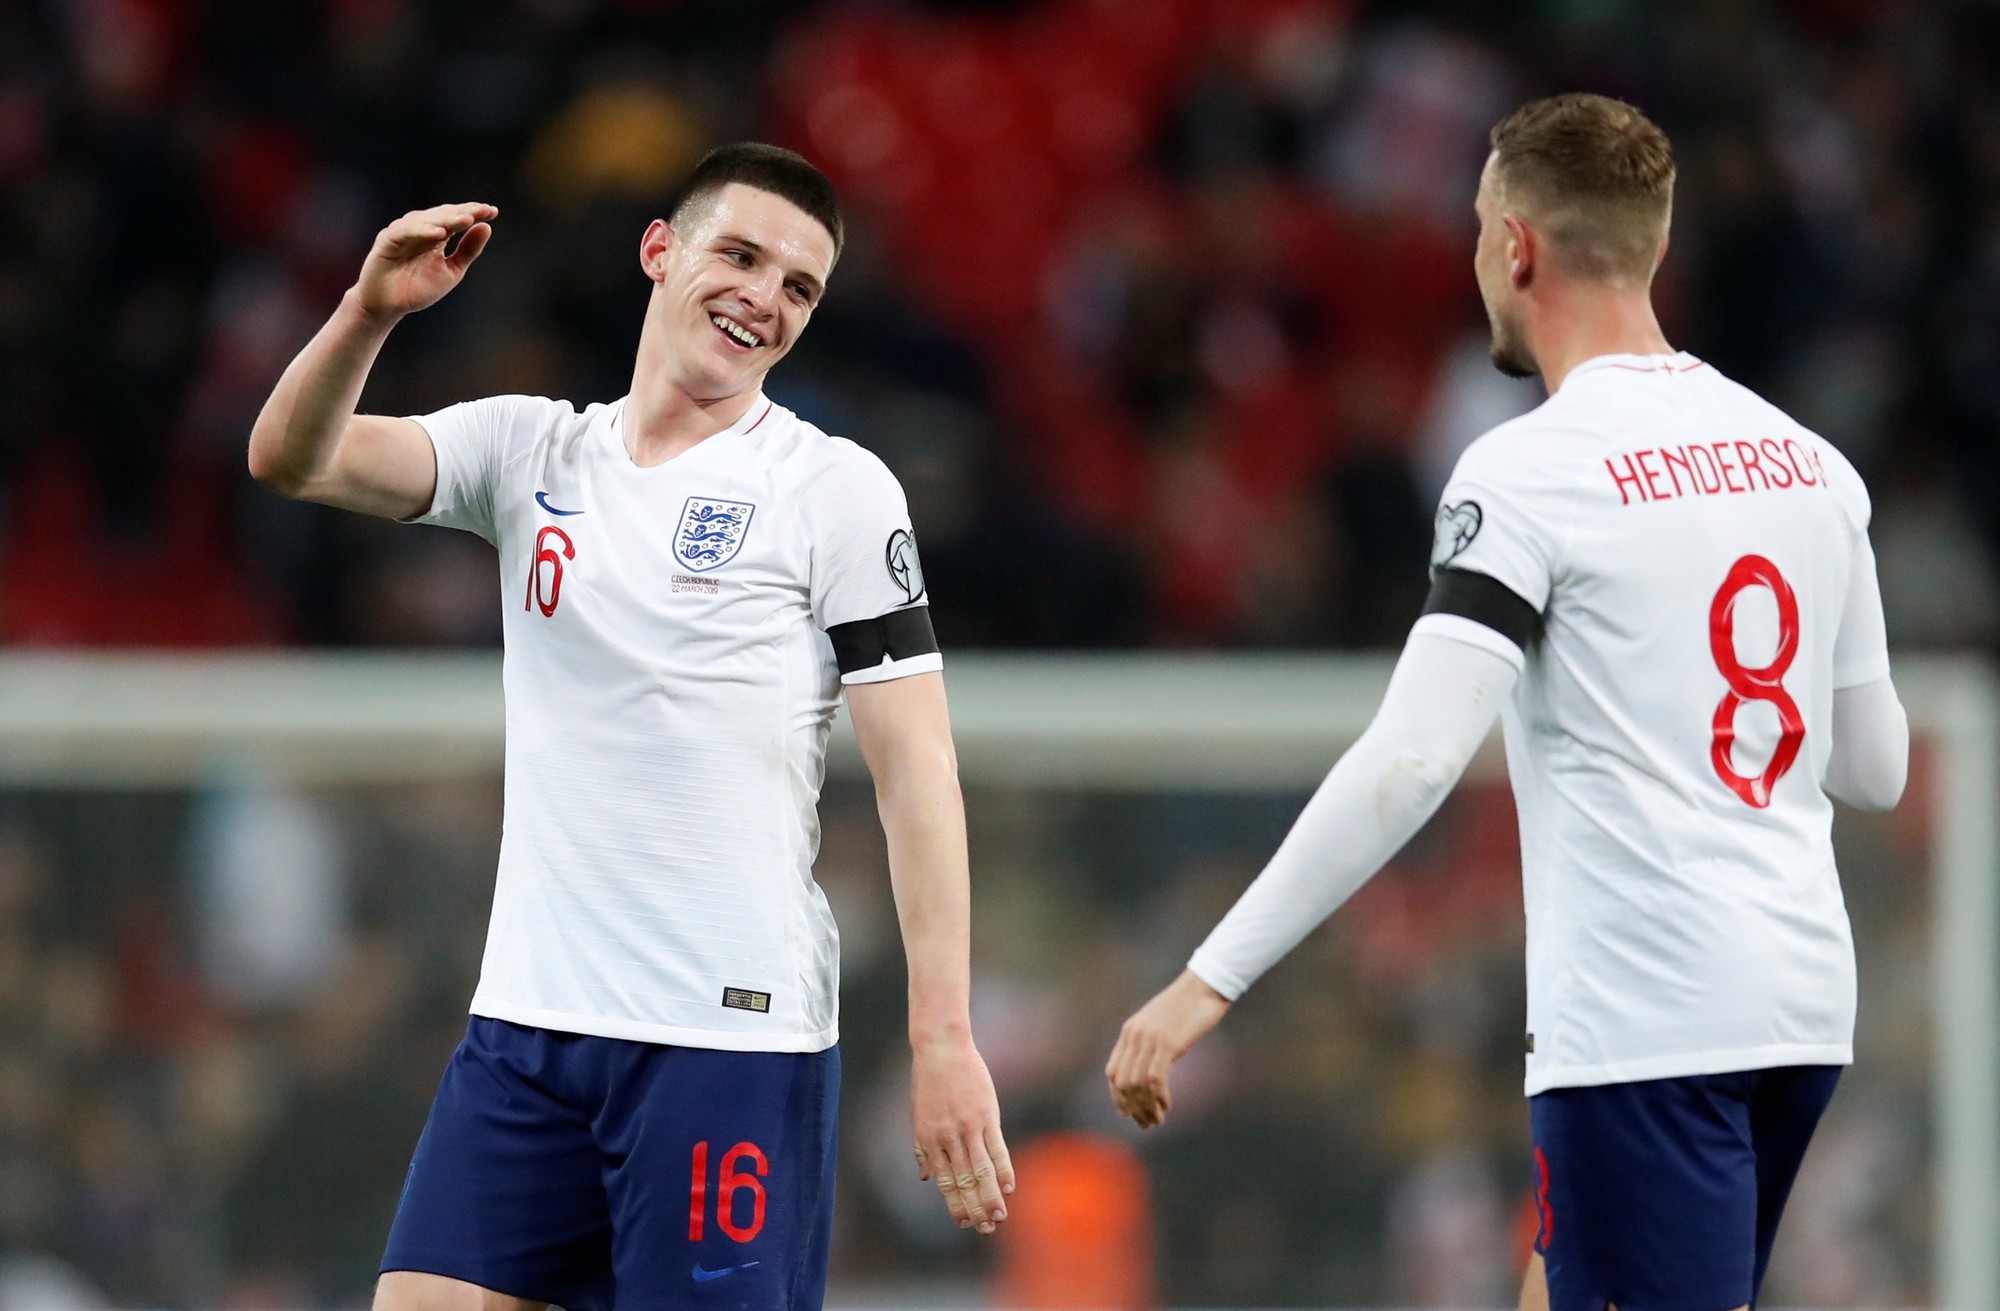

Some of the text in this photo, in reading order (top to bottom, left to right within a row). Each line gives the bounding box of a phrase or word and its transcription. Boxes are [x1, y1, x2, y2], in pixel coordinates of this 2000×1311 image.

[525, 526, 575, 618] 16
[671, 575, 720, 586] CZECH REPUBLIC
[672, 584, 719, 595] 22 MARCH 2019
[1709, 554, 1806, 809] 8
[688, 1141, 769, 1243] 16
